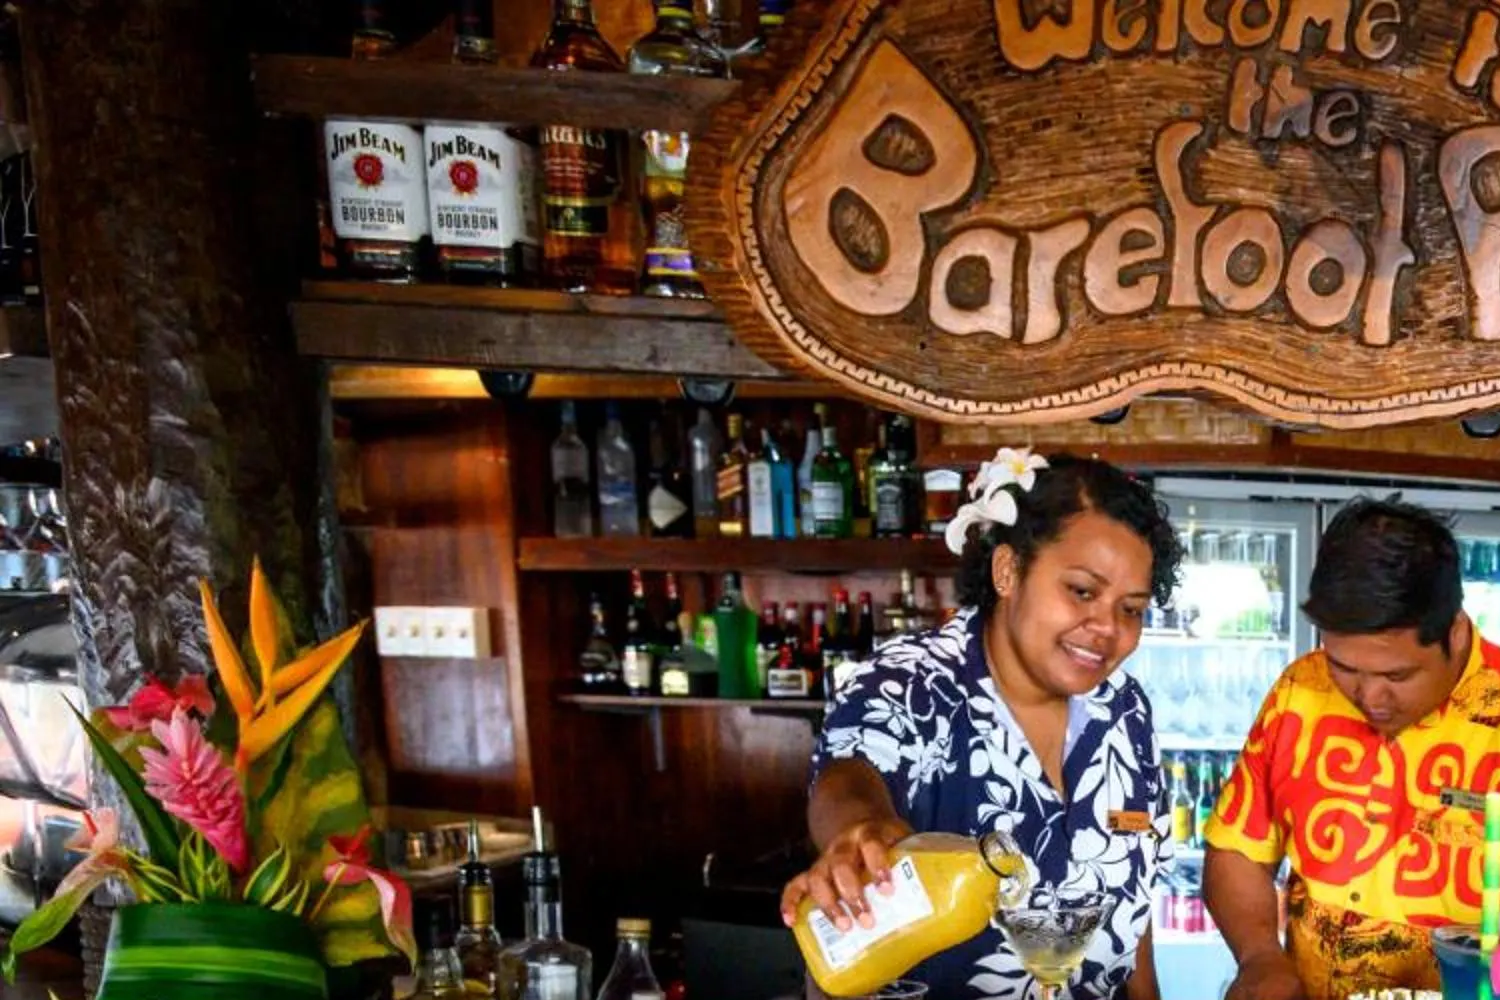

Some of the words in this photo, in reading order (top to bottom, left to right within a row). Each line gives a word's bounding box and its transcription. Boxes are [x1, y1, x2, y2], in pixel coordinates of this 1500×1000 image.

[331, 133, 357, 160] JIM
[360, 128, 405, 164] BEAM
[429, 140, 453, 167] JIM
[456, 136, 501, 169] BEAM
[785, 39, 1416, 346] Barefoot
[342, 205, 405, 225] BOURBON
[437, 213, 498, 230] BOURBON
